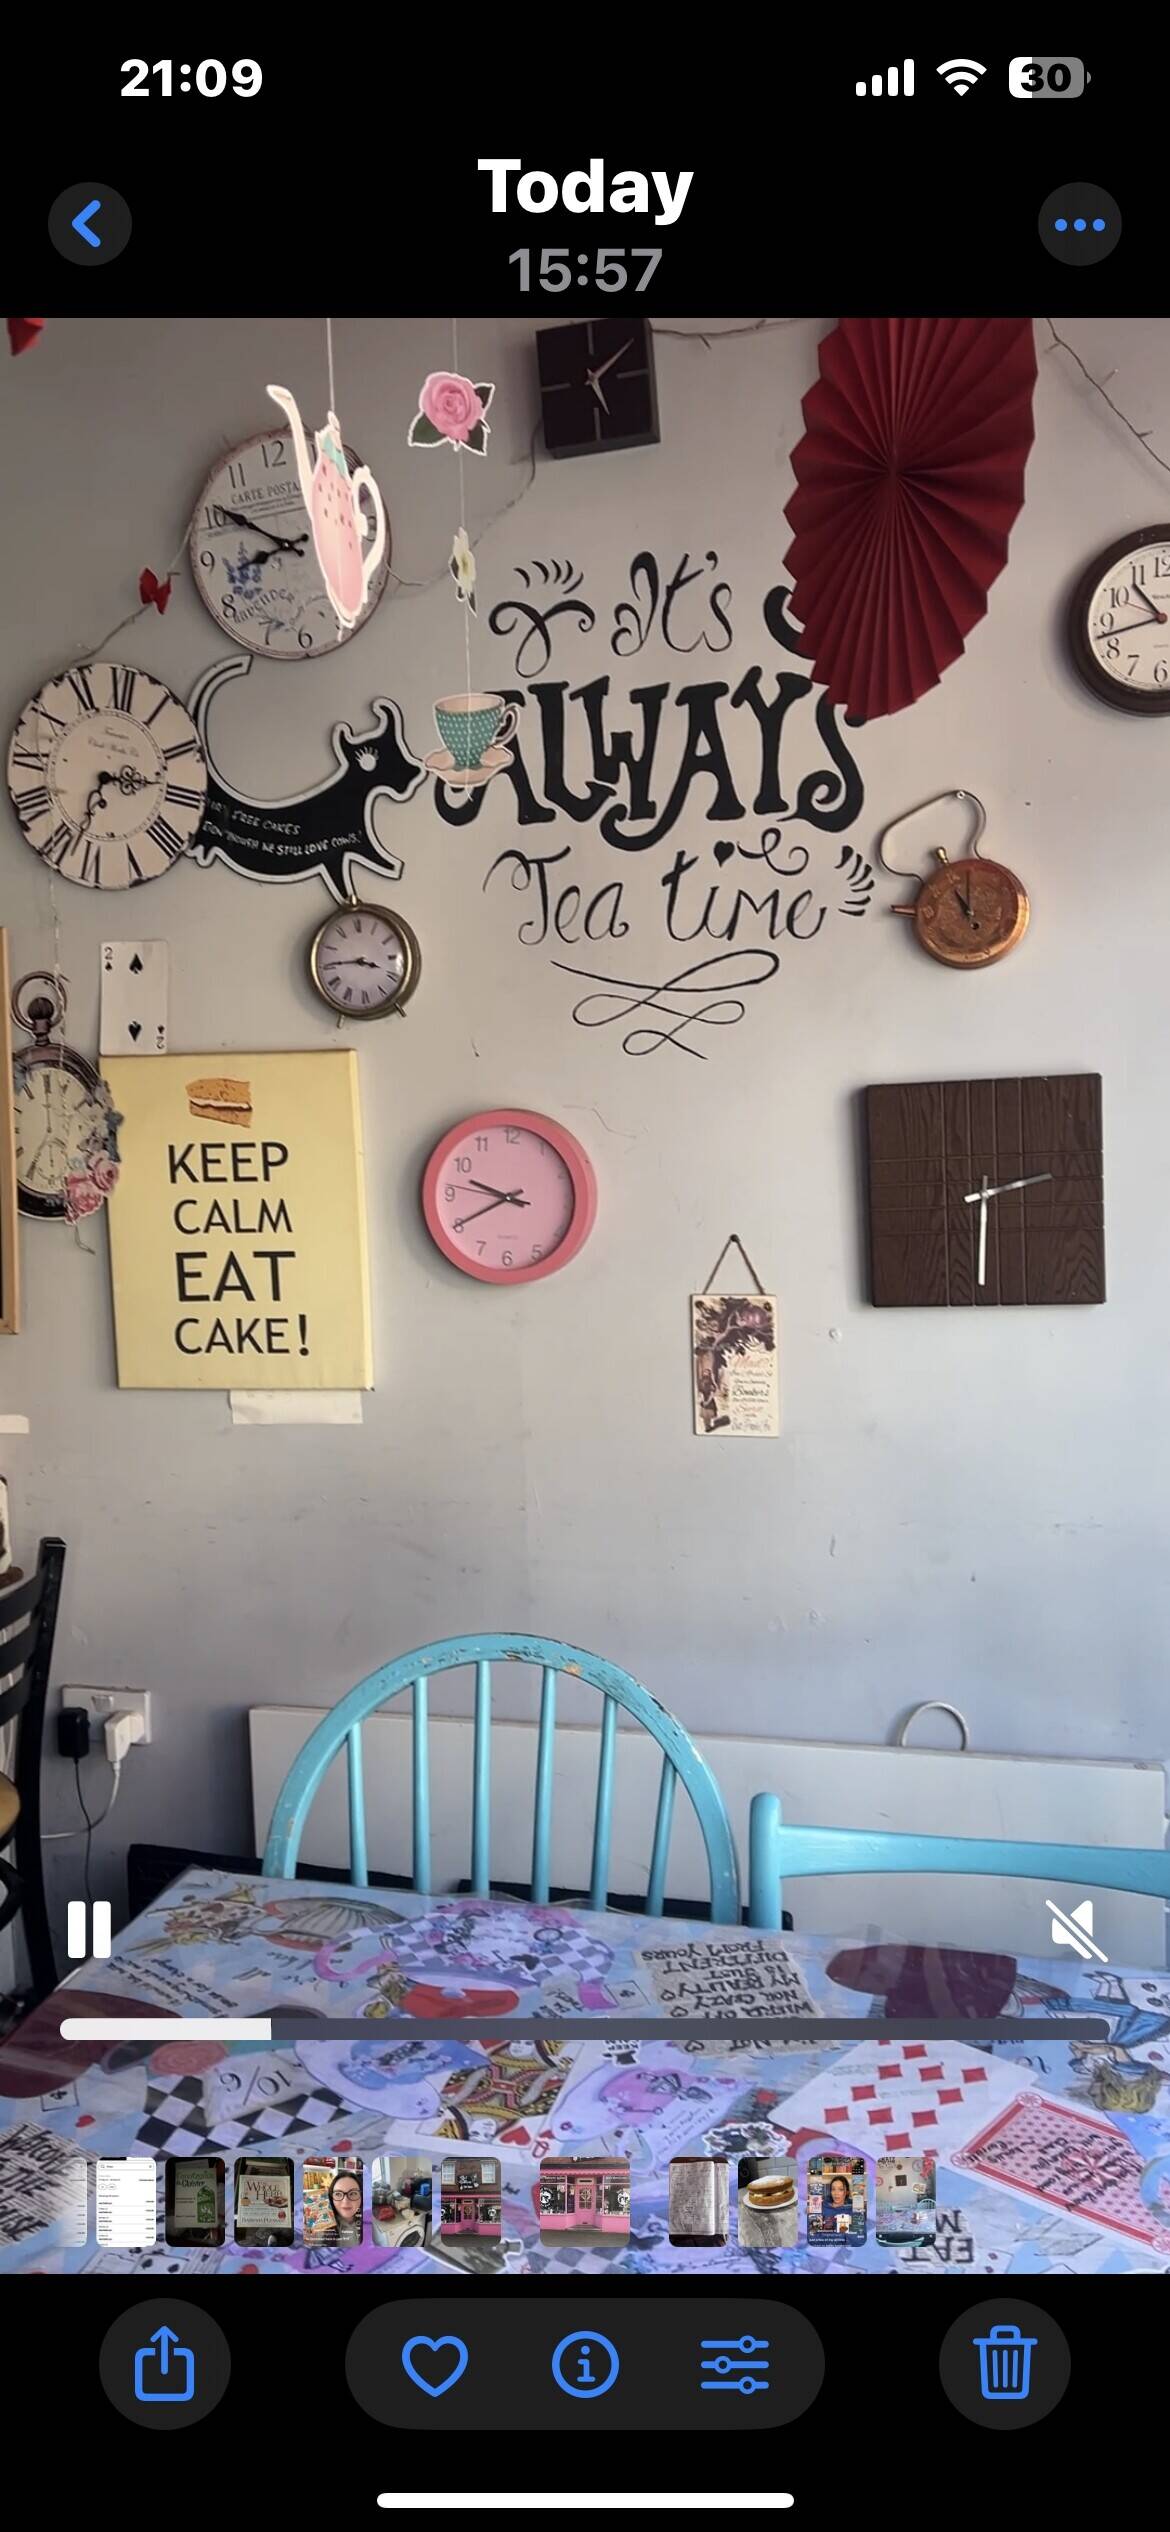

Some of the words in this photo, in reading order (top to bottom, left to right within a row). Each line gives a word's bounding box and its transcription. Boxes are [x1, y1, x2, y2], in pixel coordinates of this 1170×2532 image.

[261, 440, 287, 468] 12
[229, 463, 246, 489] 11
[267, 480, 300, 498] POSTA
[200, 551, 215, 574] 9
[1131, 564, 1145, 585] 11
[221, 594, 236, 619] 8
[611, 551, 733, 657] It's
[1110, 586, 1130, 609] 10
[1100, 612, 1114, 634] 9
[298, 628, 313, 649] 6
[1107, 637, 1120, 659] 8
[1127, 655, 1139, 676] 7
[1154, 660, 1168, 683] 6
[435, 666, 866, 851] ALWAYS
[483, 846, 630, 945] Tea
[104, 947, 113, 960] 2
[156, 1036, 165, 1049] 2
[474, 1136, 488, 1152] 11
[504, 1129, 521, 1144] 12
[168, 1141, 289, 1184] KEEP
[454, 1157, 472, 1173] 10
[445, 1186, 456, 1202] 9
[173, 1198, 293, 1235] CALM
[453, 1218, 464, 1234] 8
[476, 1240, 487, 1256] 7
[502, 1250, 513, 1267] 6
[532, 1244, 544, 1261] 5
[175, 1251, 296, 1302] EAT
[175, 1314, 309, 1356] CAKE!
[641, 1943, 701, 1961] YOURS
[706, 1940, 765, 1956] FROM
[663, 1951, 789, 1975] DIFFERENT
[678, 1980, 765, 1998] REALITY
[770, 1972, 801, 1987] MY
[695, 1993, 755, 2010] CRAZY
[760, 1989, 798, 2002] NOR
[218, 2065, 292, 2106] 10/6
[936, 2210, 962, 2233] M
[901, 2237, 974, 2264] EAT
